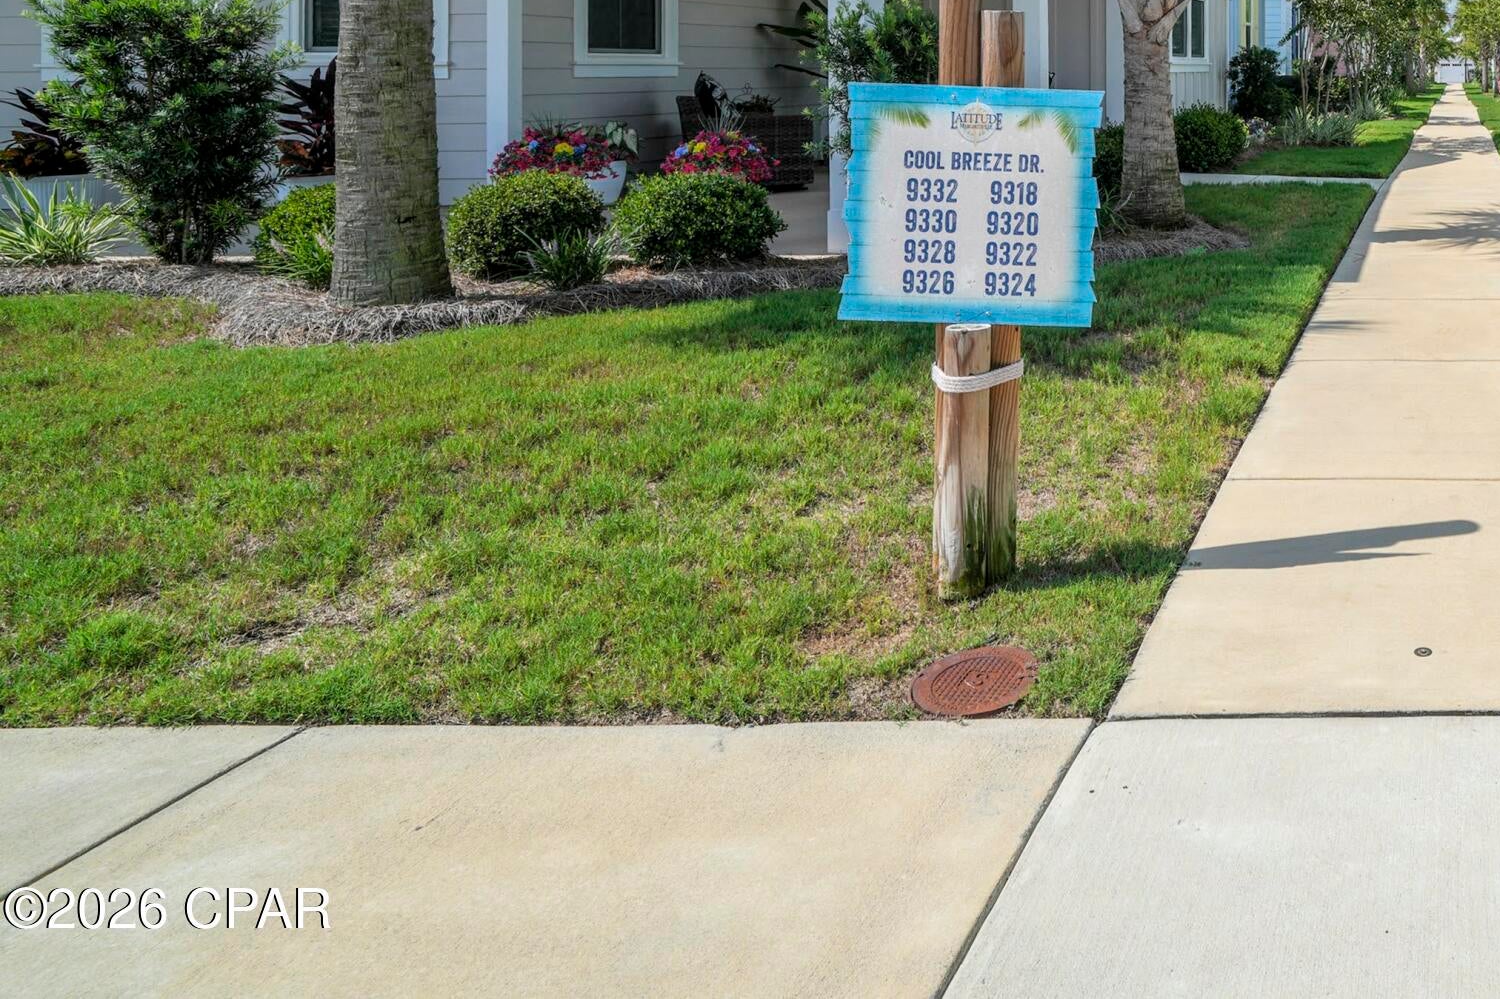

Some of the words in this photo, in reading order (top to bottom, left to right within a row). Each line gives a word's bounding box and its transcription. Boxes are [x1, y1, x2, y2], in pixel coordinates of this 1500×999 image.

[951, 111, 1003, 130] LATITUDE
[903, 149, 945, 170] COOL
[951, 151, 1013, 172] BREEZE
[1018, 153, 1045, 174] DR.
[906, 177, 958, 203] 9332
[990, 180, 1038, 206] 9318
[904, 208, 957, 234] 9330
[987, 210, 1039, 236] 9320
[903, 239, 956, 264] 9328
[985, 241, 1037, 267] 9322
[902, 269, 955, 295] 9326
[984, 271, 1036, 297] 9324
